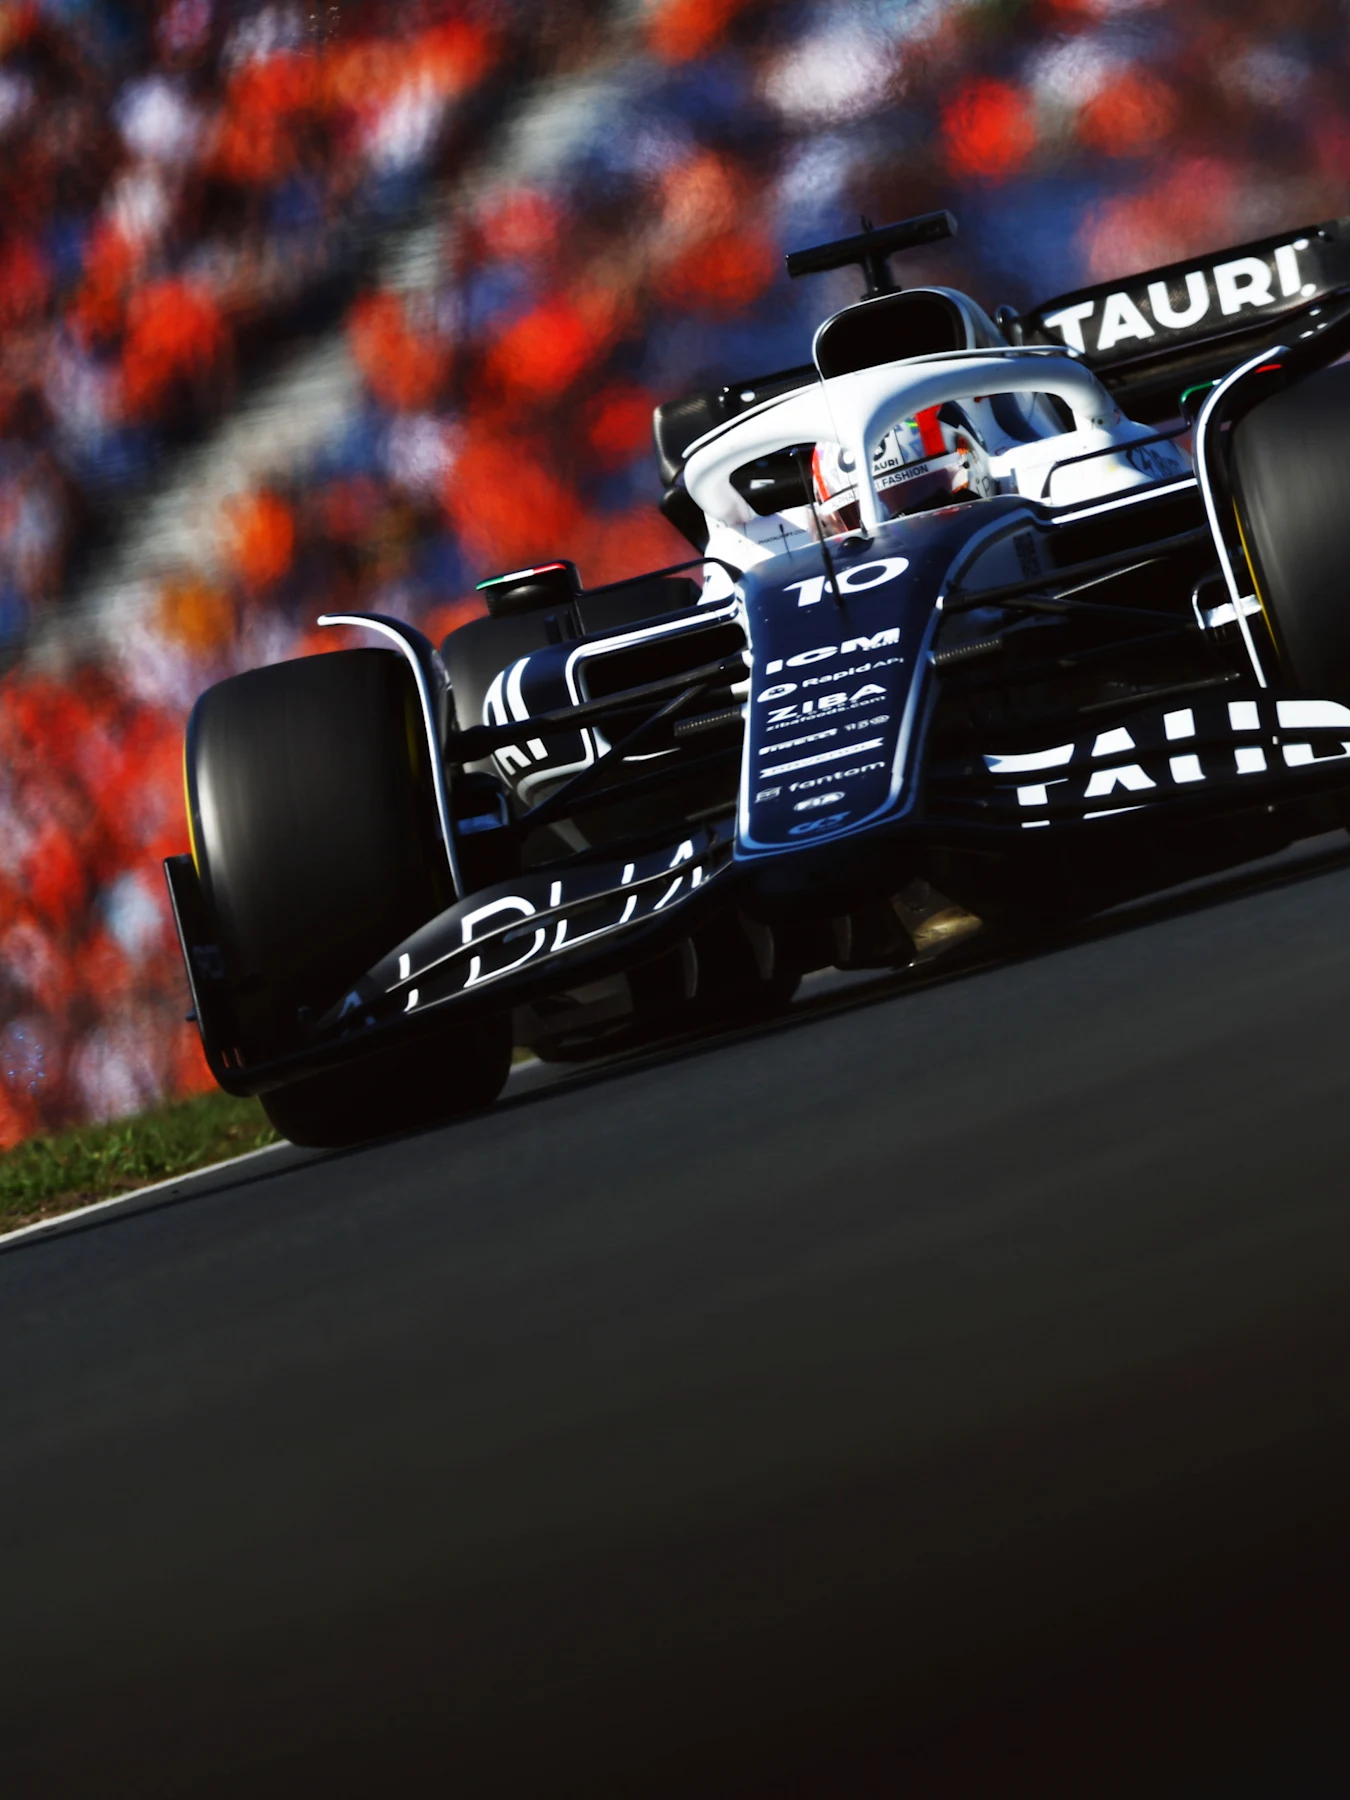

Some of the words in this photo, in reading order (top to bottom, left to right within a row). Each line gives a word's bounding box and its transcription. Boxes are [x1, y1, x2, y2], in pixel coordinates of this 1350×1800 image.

[1044, 243, 1303, 358] TAURI
[873, 457, 899, 472] AURI
[881, 464, 929, 487] FASHION
[783, 556, 910, 608] 10
[765, 627, 901, 675] ICM
[802, 657, 905, 688] RapidAPI
[766, 683, 888, 724] ZIBA
[766, 696, 887, 732] zibafoods.com
[788, 761, 886, 792] fantom
